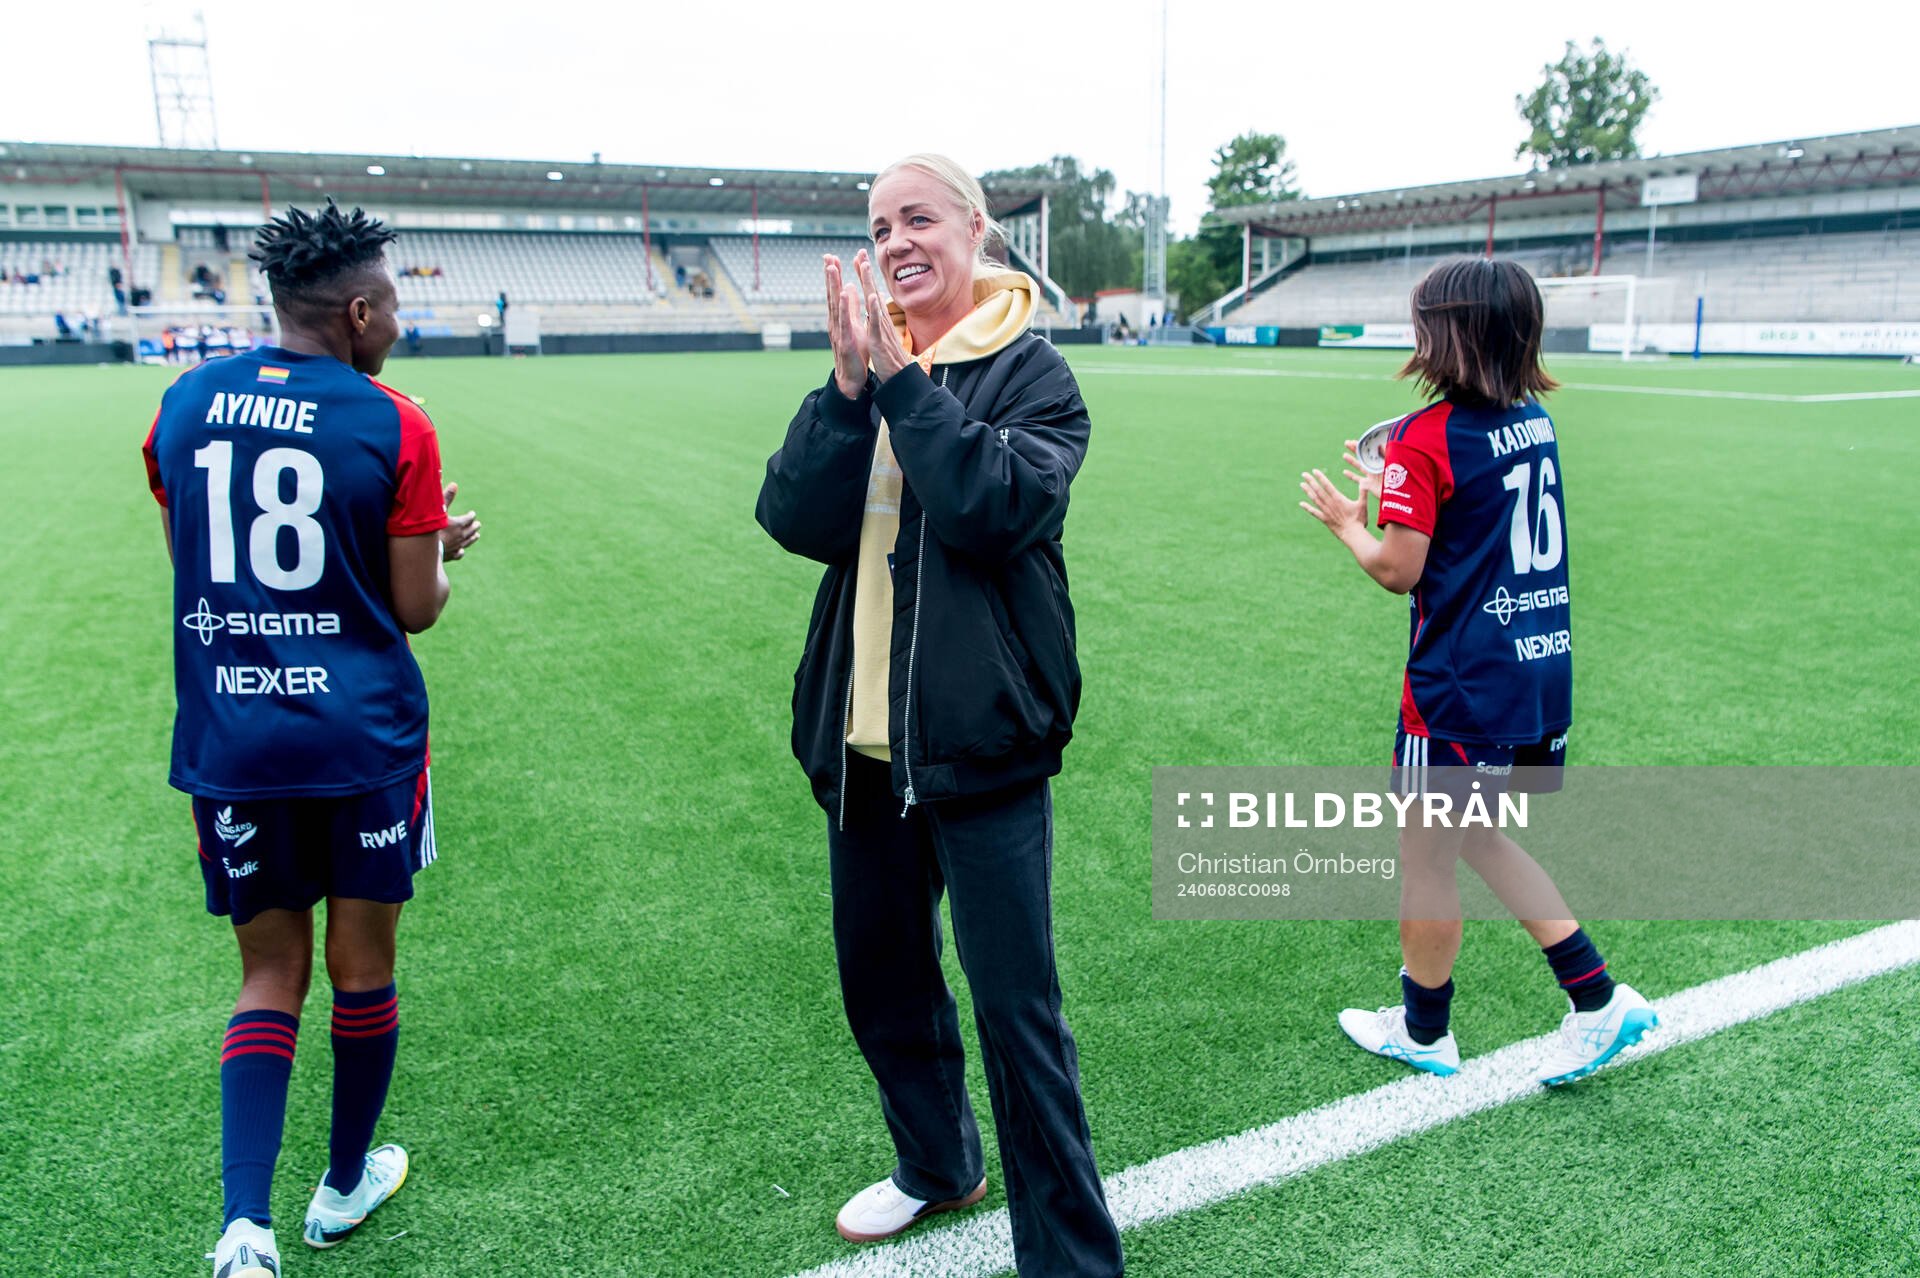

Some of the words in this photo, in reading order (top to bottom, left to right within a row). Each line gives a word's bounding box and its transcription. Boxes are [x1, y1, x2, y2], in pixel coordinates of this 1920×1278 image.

[205, 392, 318, 434] AYINDE
[194, 440, 325, 591] 18
[1503, 457, 1563, 575] 16
[359, 820, 408, 848] RWE
